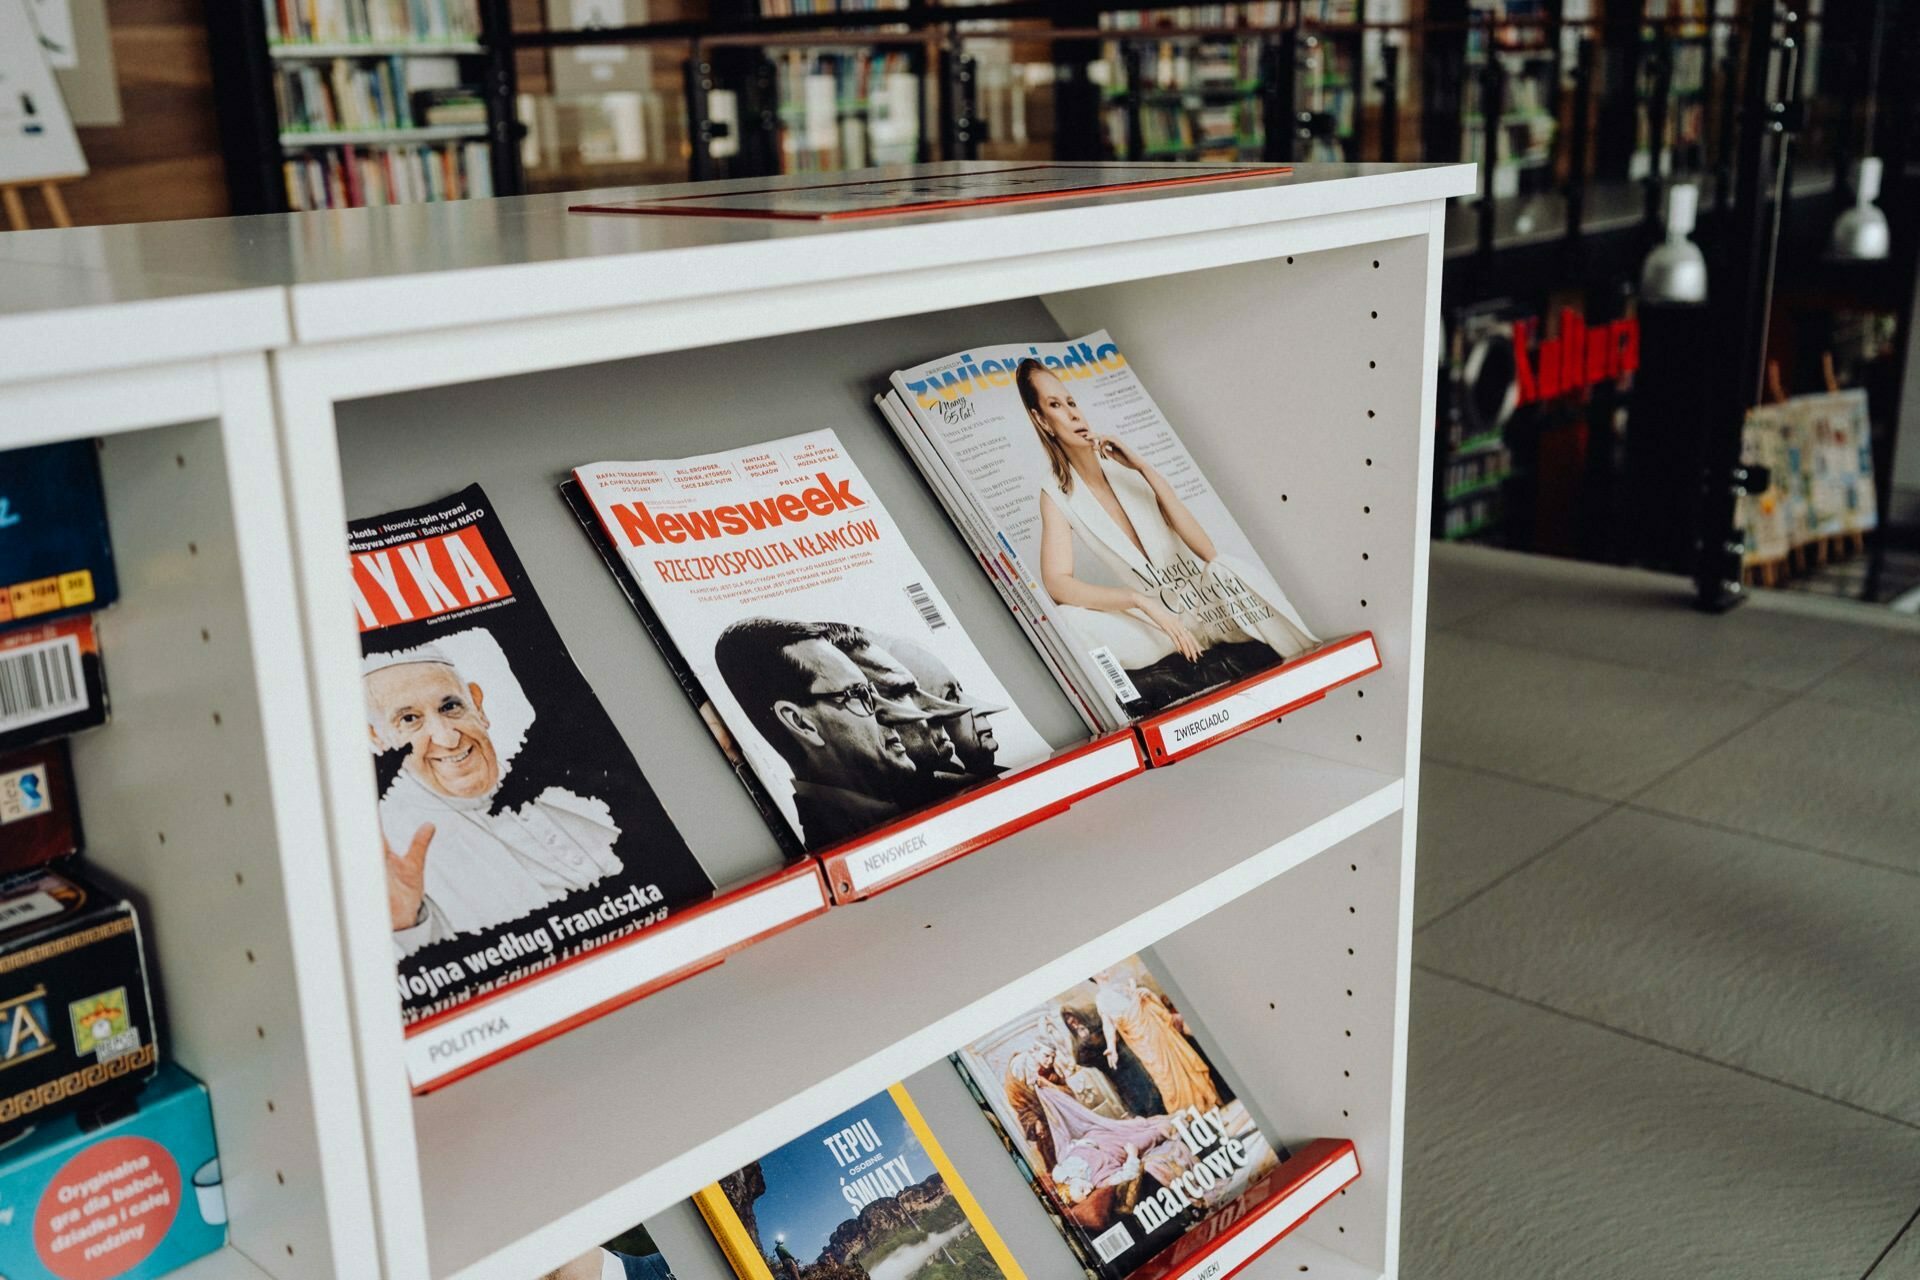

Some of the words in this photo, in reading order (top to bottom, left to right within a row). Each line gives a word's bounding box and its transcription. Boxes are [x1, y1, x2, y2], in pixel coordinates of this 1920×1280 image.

[929, 397, 967, 414] Mamy
[944, 410, 959, 424] 65
[959, 402, 976, 421] lat!
[742, 454, 770, 464] FANTAZJE
[744, 461, 777, 472] SEKSUALNE
[779, 475, 810, 487] POLSKA
[383, 519, 419, 532] Nowość:
[420, 514, 438, 526] spin
[439, 502, 467, 519] tyrani
[610, 472, 866, 547] Newsweek
[349, 540, 384, 552] ałszywa
[385, 532, 417, 545] wiosna
[422, 523, 448, 536] Bałtyk
[449, 520, 458, 529] w
[458, 508, 485, 525] NATO
[654, 541, 798, 583] RZECZPOSPOLITA
[793, 519, 880, 558] KŁAMCÓW
[1132, 553, 1202, 591] Magda
[1160, 572, 1246, 615] Cielecka
[1197, 606, 1230, 624] MOJE
[1228, 595, 1261, 615] ŻYCIE
[1215, 618, 1234, 634] TU
[1237, 606, 1274, 626] TERAZ
[864, 834, 928, 873] NEWSWEEK
[463, 927, 554, 974] według
[548, 884, 665, 941] Franciszka
[428, 1017, 510, 1062] POLITYKA
[823, 1118, 883, 1168] TEPUI
[1171, 1104, 1229, 1156] Idy
[58, 1155, 150, 1203] Oryginalna
[849, 1152, 885, 1176] OSOBNE
[839, 1154, 916, 1217] ŚWIATY
[1133, 1138, 1249, 1235] marcowe
[51, 1208, 81, 1232] gra
[83, 1195, 110, 1216] dla
[51, 1214, 118, 1253] dziadka
[120, 1207, 127, 1222] i
[129, 1188, 170, 1217] całej
[84, 1224, 146, 1261] rodziny
[1198, 1261, 1220, 1280] WIEKI
